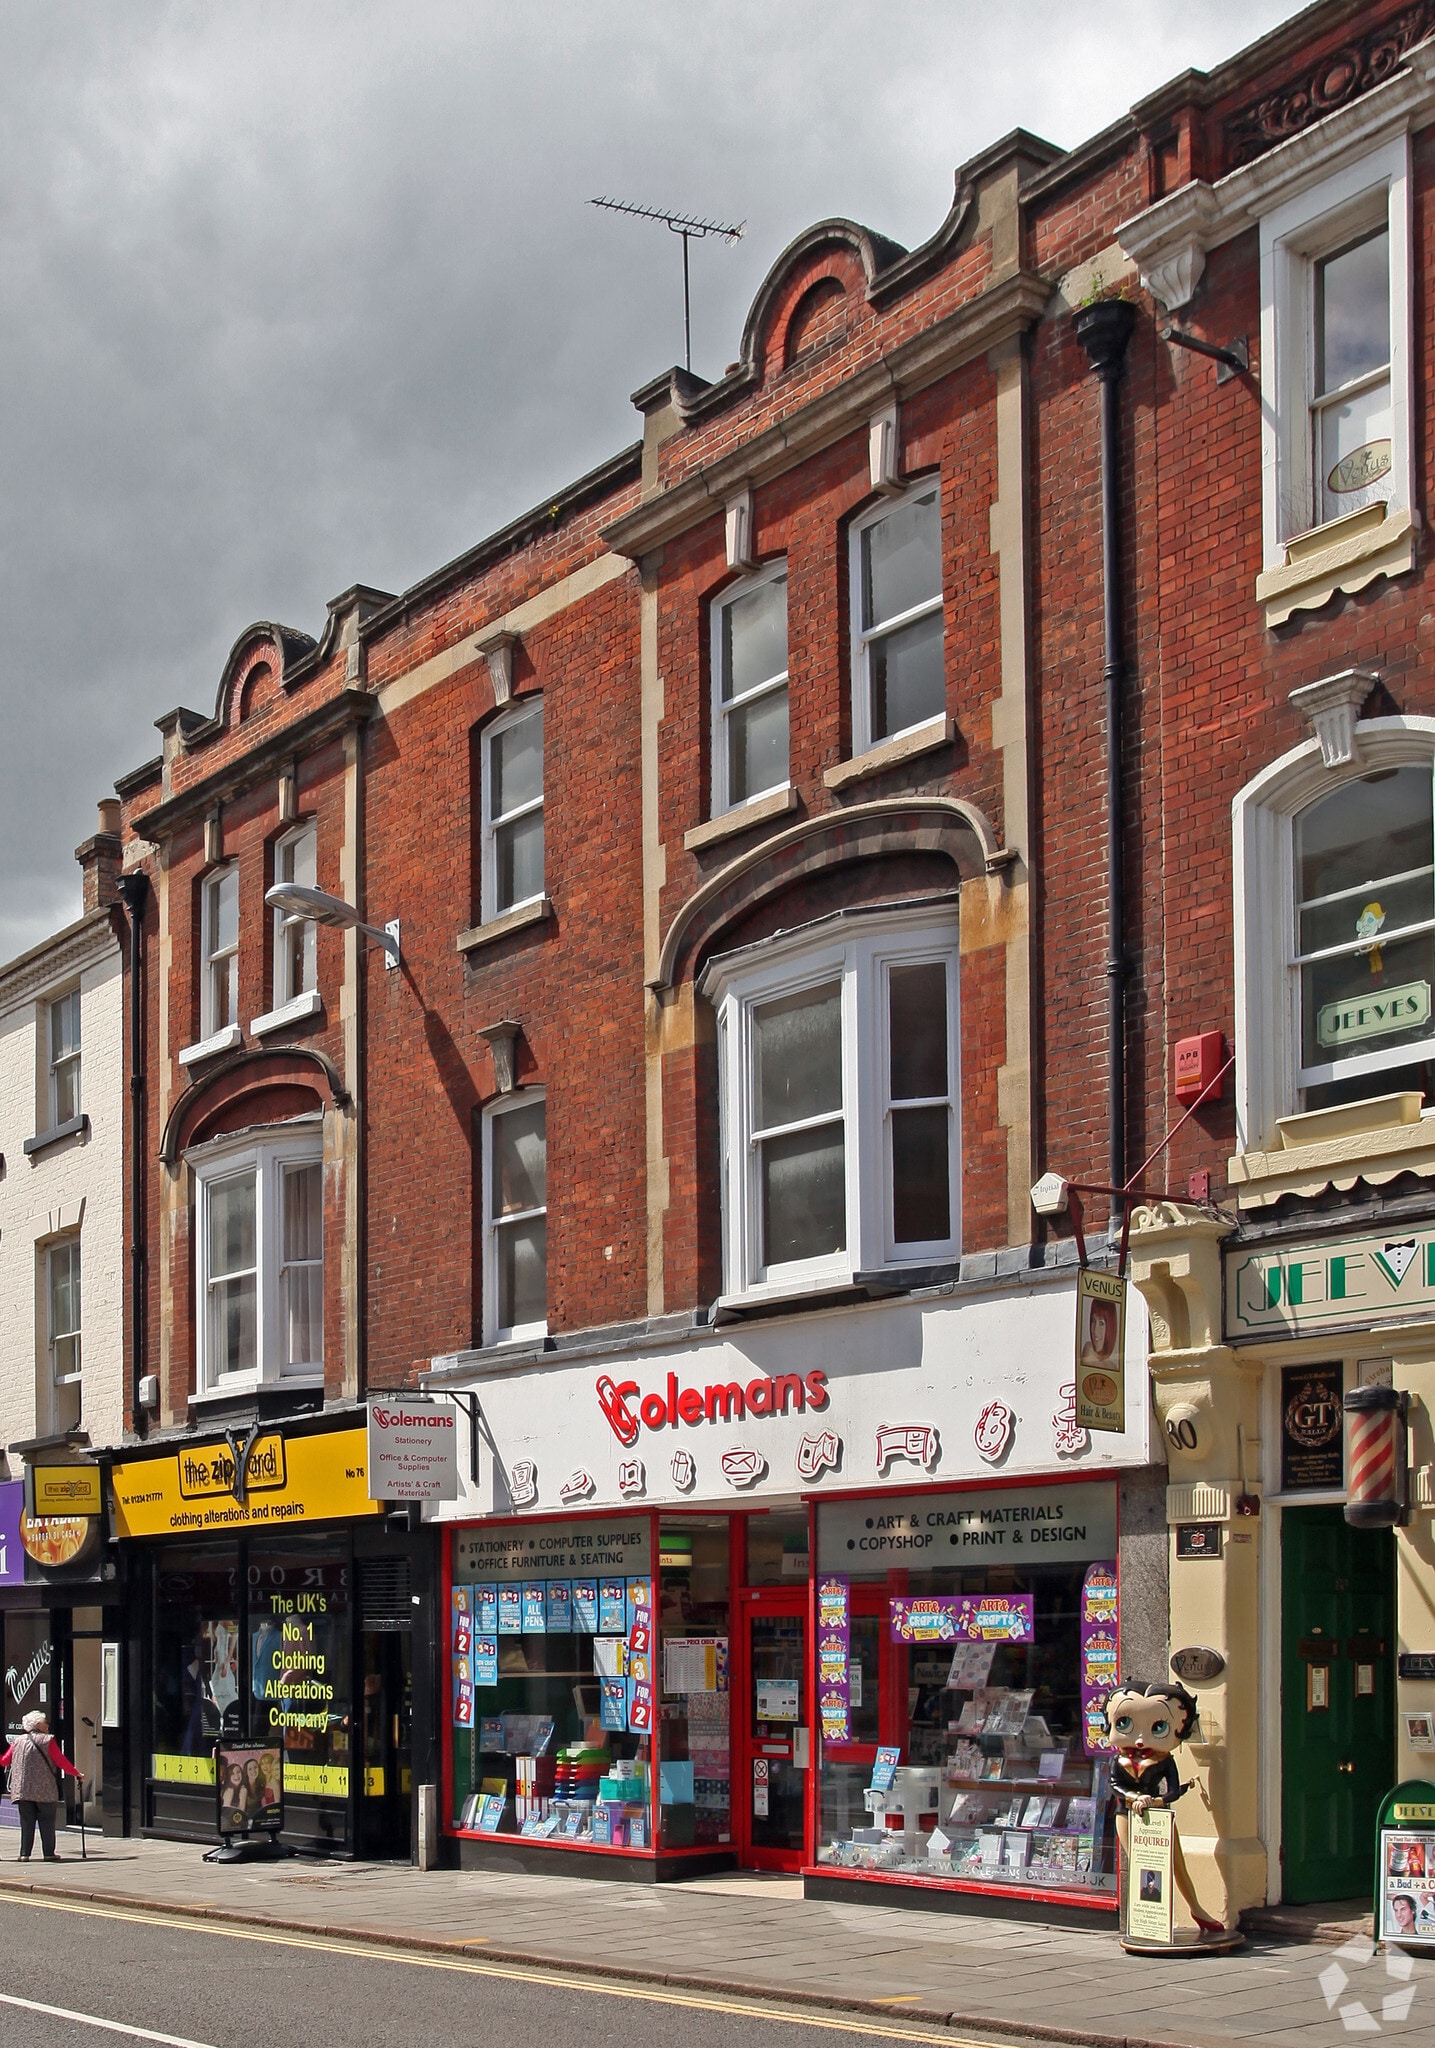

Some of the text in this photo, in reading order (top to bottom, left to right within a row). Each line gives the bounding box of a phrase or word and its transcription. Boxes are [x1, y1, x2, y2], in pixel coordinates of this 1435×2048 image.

[1327, 996, 1418, 1034] JEEVES
[1084, 1276, 1123, 1297] VENUS
[597, 1370, 827, 1443] Colemans
[1080, 1404, 1092, 1417] Hair
[1095, 1407, 1101, 1418] &
[373, 1406, 453, 1429] Colemans
[1295, 1402, 1332, 1429] GT
[1301, 1428, 1326, 1436] RALLY
[395, 1437, 432, 1446] Stationery
[380, 1454, 401, 1462] Office
[411, 1455, 447, 1463] Computer
[398, 1463, 430, 1471] Supplies
[184, 1458, 210, 1485] the
[345, 1467, 365, 1479] No 76
[170, 1502, 304, 1527] clothing alterations and repairs
[876, 1505, 1064, 1529] ART & CRAFT MATERIALS
[469, 1533, 641, 1553] STATIONERY COMPUTER SUPPLIES
[859, 1527, 1087, 1550] COPYSHOP PRINT & DESIGN
[478, 1552, 623, 1569] OFFICE FURNITURE & SEATING
[457, 1594, 466, 1611] 3
[633, 1586, 645, 1605] 3
[1087, 1589, 1117, 1599] CRAFTS
[270, 1595, 293, 1613] The
[297, 1594, 327, 1612] UK's
[527, 1604, 541, 1615] ALL
[459, 1615, 470, 1628] FOR
[524, 1616, 544, 1627] PENS
[636, 1610, 648, 1624] FOR
[909, 1614, 946, 1627] CRAFTS
[976, 1613, 1015, 1626] CRAFTS
[282, 1622, 313, 1642] No. 1
[635, 1630, 646, 1650] 2
[458, 1634, 467, 1651] 2
[272, 1651, 325, 1674] Clothing
[1087, 1652, 1117, 1662] CRAFTS
[458, 1662, 467, 1679] 3
[634, 1661, 645, 1681] 3
[265, 1680, 333, 1699] Alterations
[460, 1683, 471, 1697] FOR
[636, 1685, 649, 1699] FOR
[269, 1707, 329, 1733] Company
[459, 1703, 468, 1720] 2
[635, 1706, 646, 1726] 2
[163, 1763, 167, 1772] 1
[178, 1764, 183, 1773] 2
[194, 1765, 199, 1774] 3
[319, 1775, 328, 1784] 10
[338, 1776, 347, 1785] 11
[1134, 1835, 1169, 1847] REQUIRED
[1397, 1879, 1411, 1888] Bud
